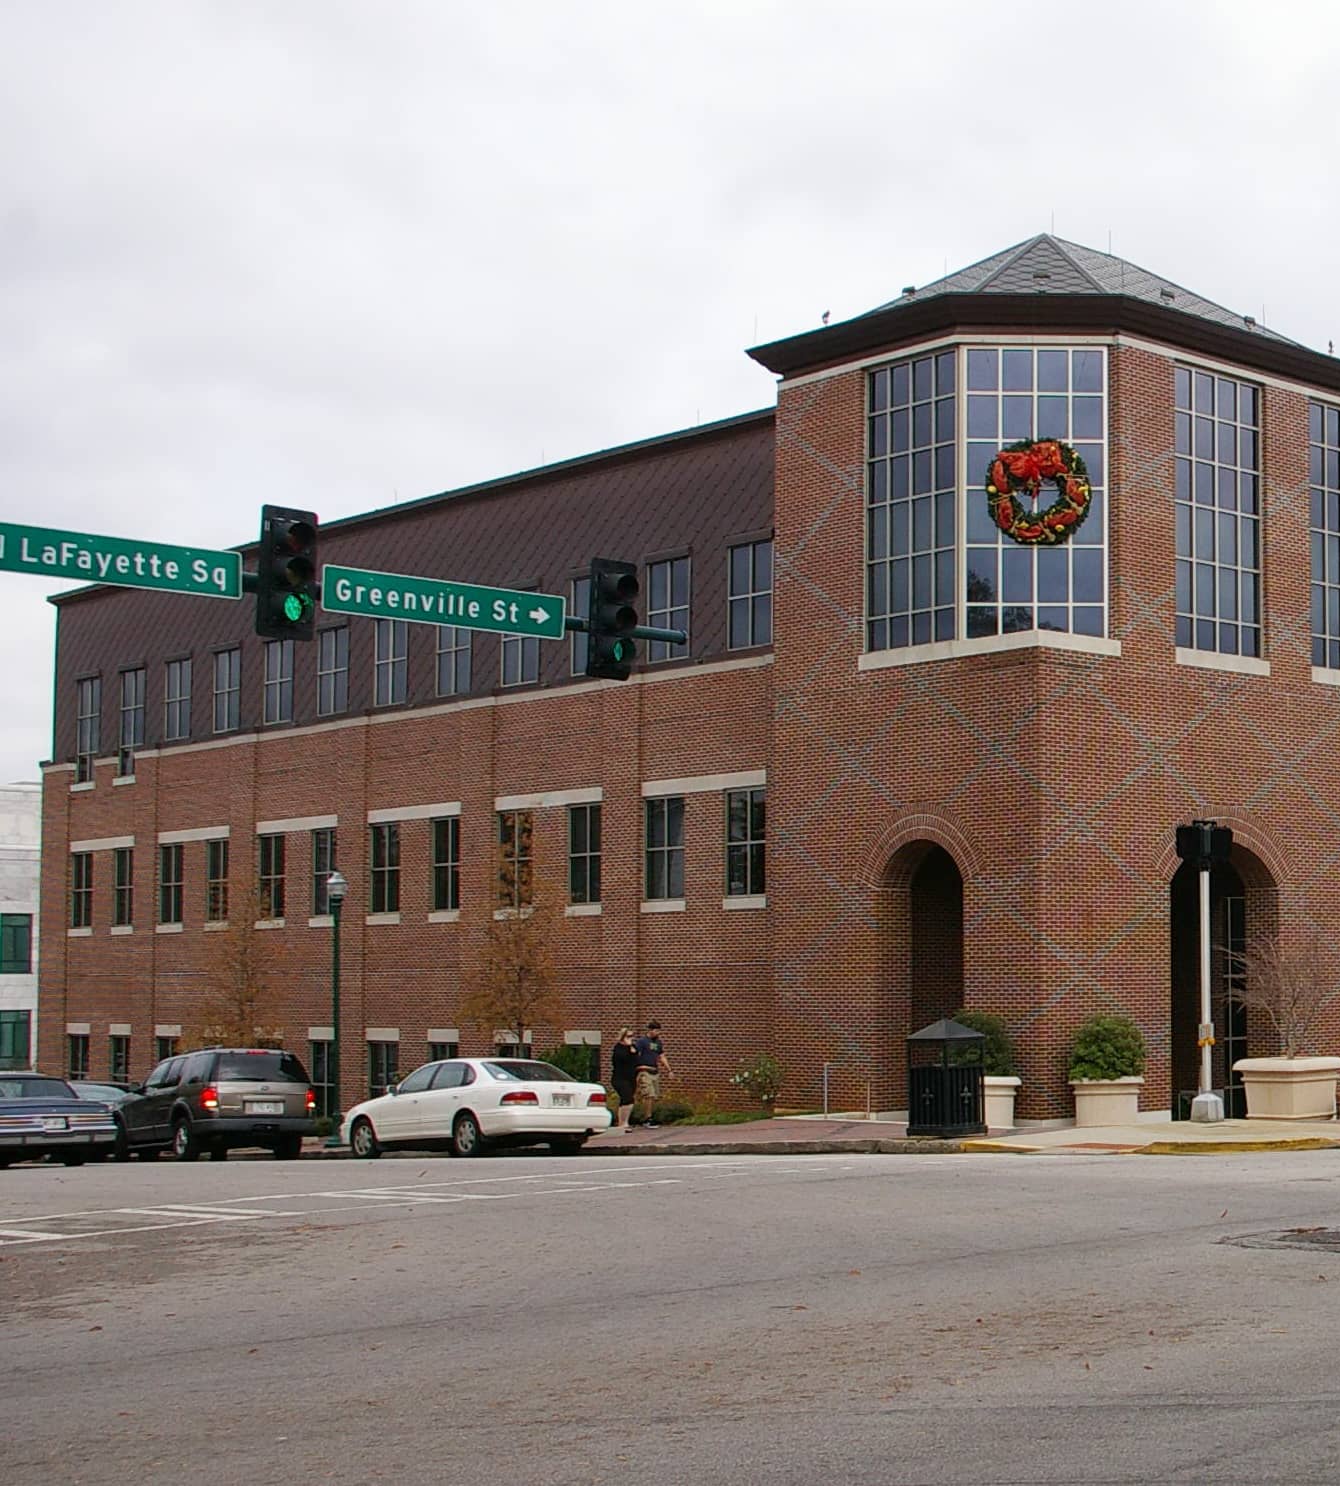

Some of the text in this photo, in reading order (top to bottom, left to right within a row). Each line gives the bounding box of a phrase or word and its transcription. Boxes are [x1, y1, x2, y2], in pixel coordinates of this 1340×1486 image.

[21, 538, 179, 580] LaFayette
[192, 559, 226, 592] Sq
[336, 579, 519, 623] Greenville St
